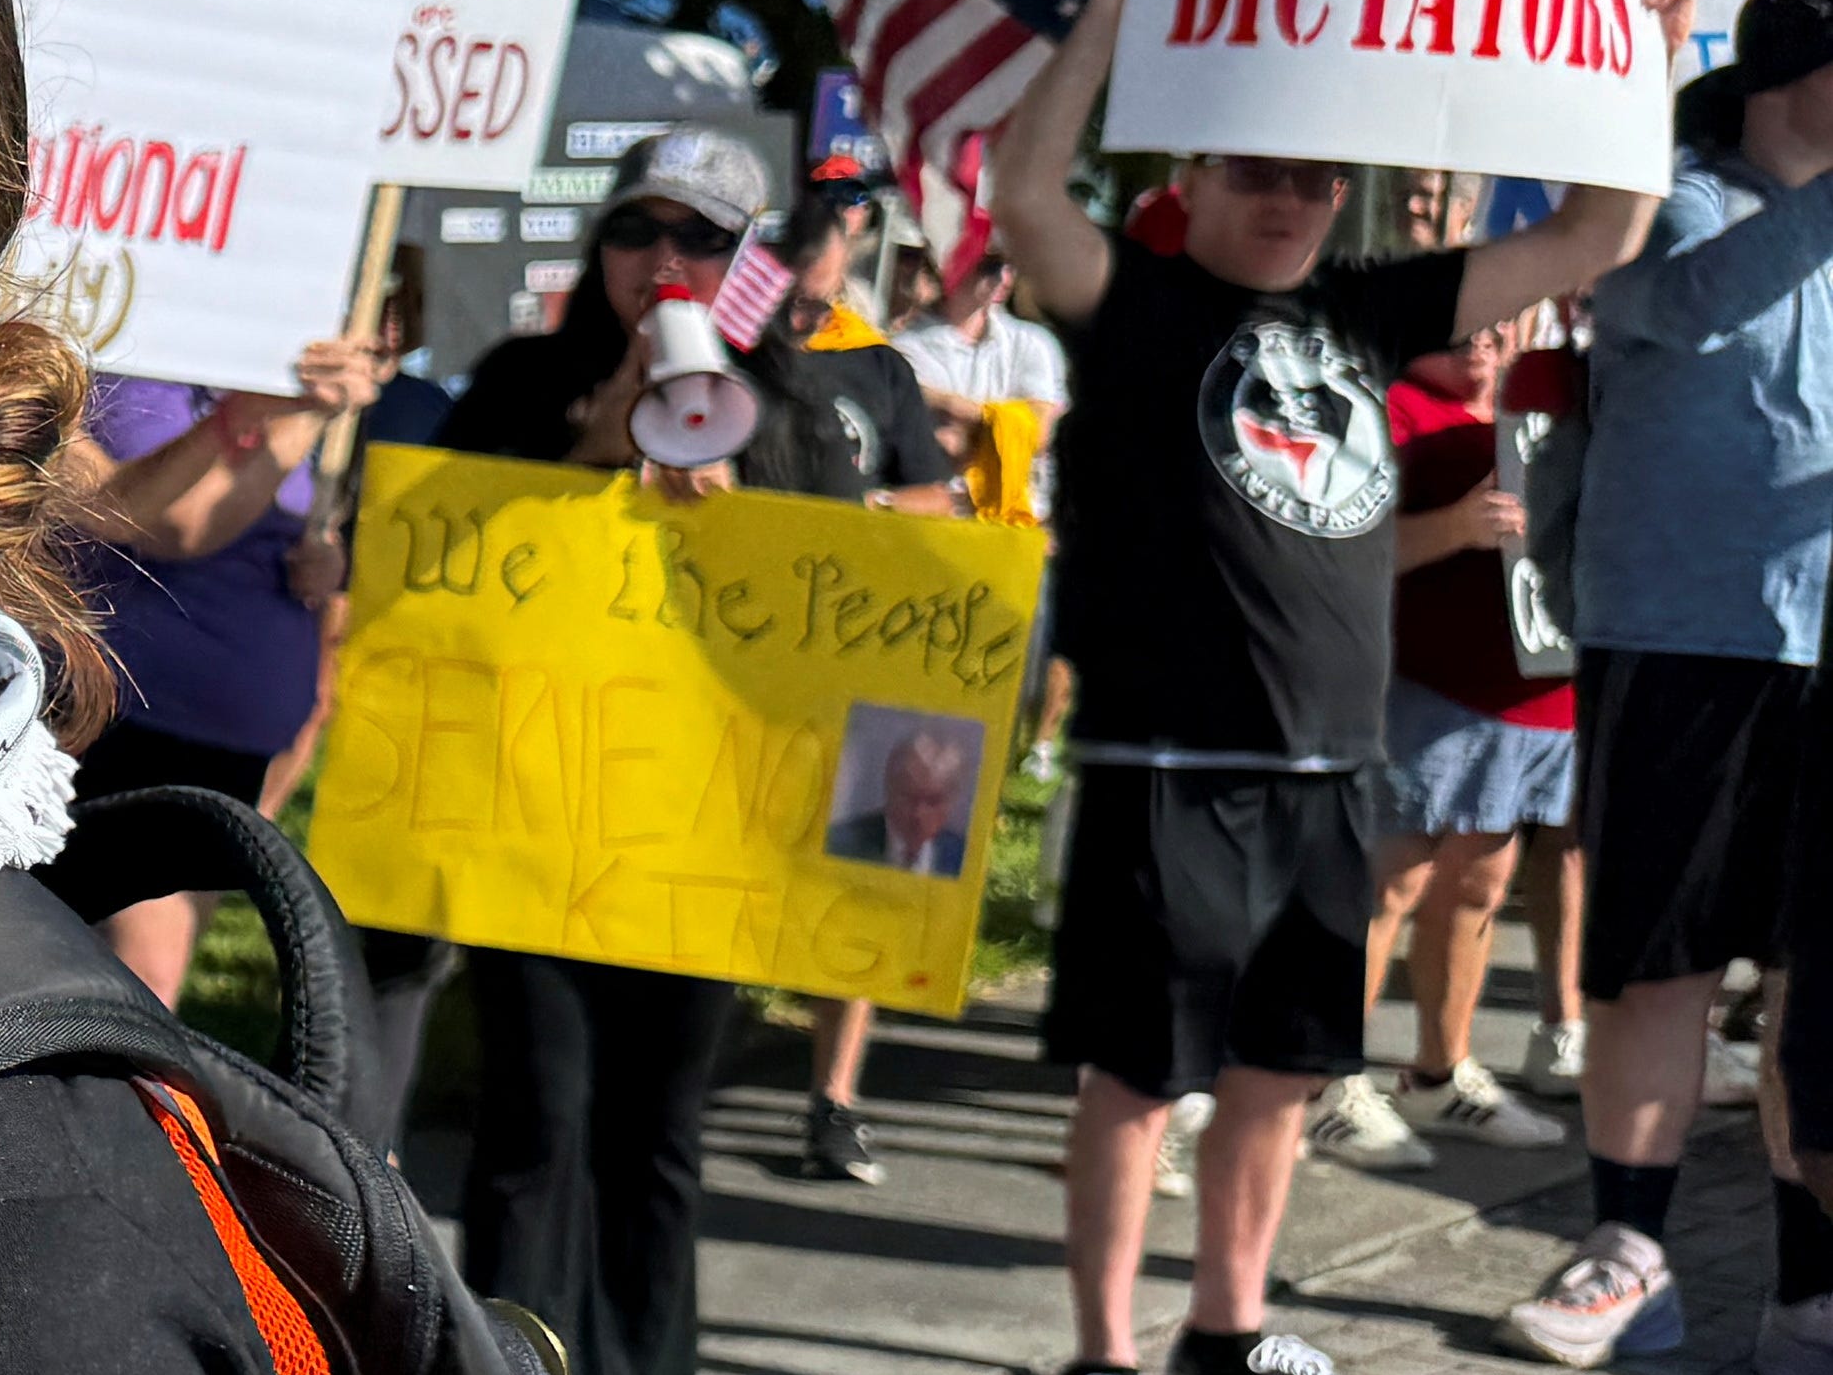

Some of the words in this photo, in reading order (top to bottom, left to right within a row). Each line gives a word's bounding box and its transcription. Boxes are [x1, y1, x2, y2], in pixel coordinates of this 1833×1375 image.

[388, 503, 553, 611] We
[605, 519, 772, 644] the
[790, 552, 1025, 688] People
